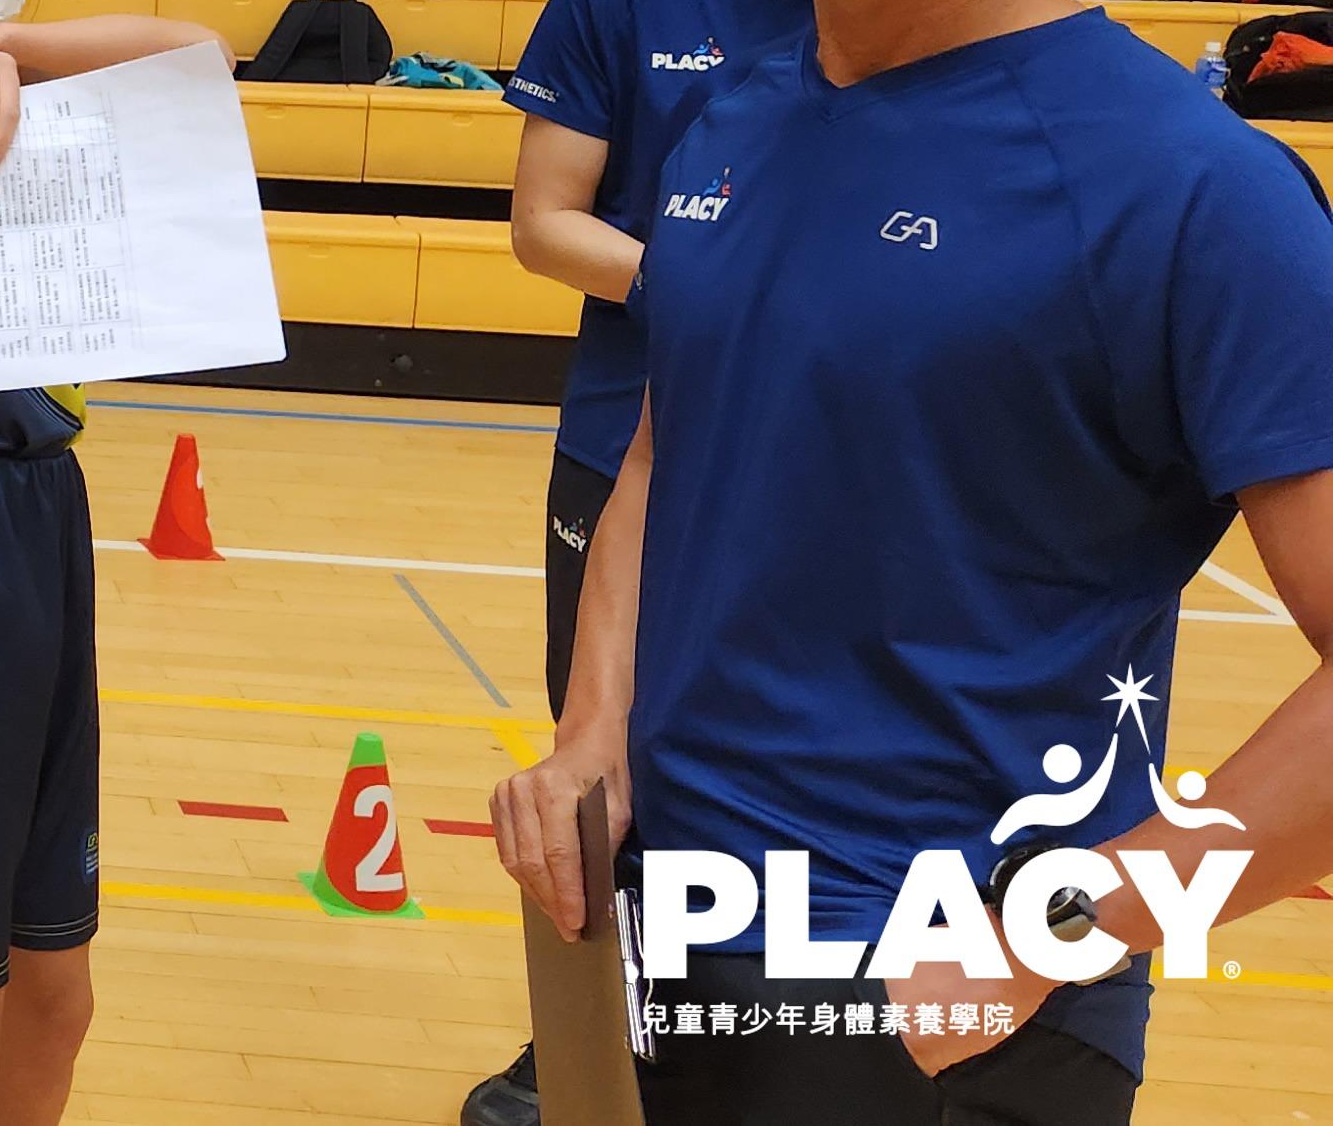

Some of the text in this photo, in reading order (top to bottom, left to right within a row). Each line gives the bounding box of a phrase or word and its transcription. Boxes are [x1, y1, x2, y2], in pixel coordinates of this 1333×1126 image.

[651, 52, 726, 72] PLACY
[664, 194, 730, 222] PLACY
[553, 515, 587, 553] PLACY
[353, 784, 404, 893] 2
